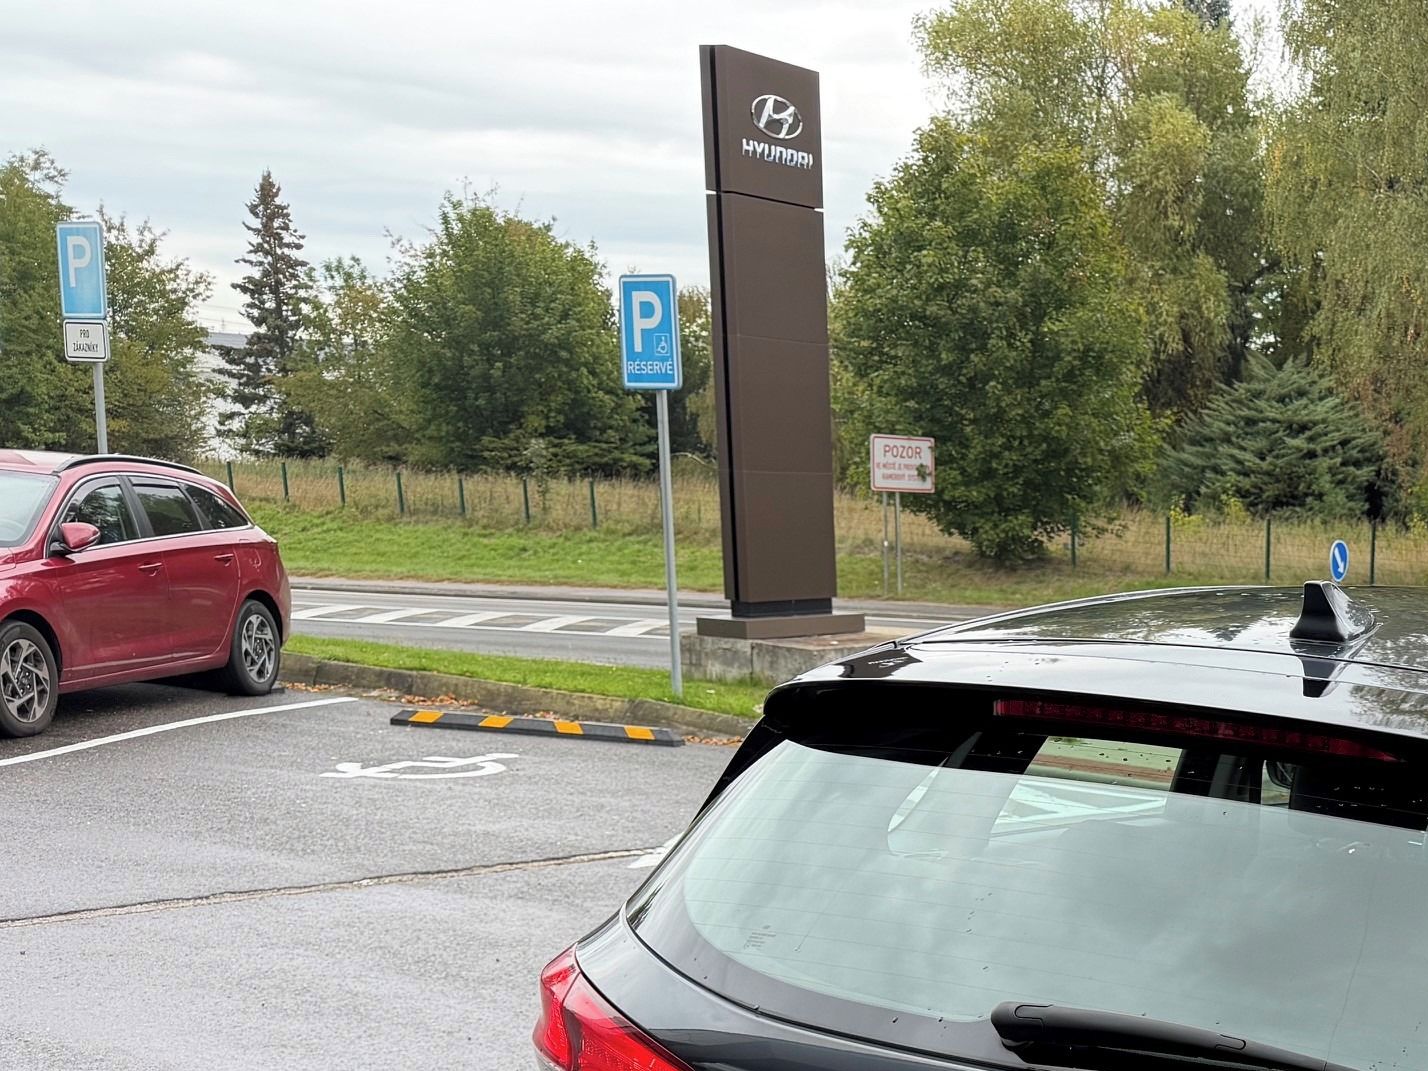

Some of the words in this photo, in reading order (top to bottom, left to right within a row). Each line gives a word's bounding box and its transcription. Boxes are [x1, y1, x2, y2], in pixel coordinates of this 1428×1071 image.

[742, 138, 814, 170] HYUNDAI
[66, 235, 92, 288] P
[79, 328, 90, 339] PRO
[632, 290, 663, 353] P
[627, 358, 673, 374] RÉSERVÉ
[883, 444, 922, 460] POZOR
